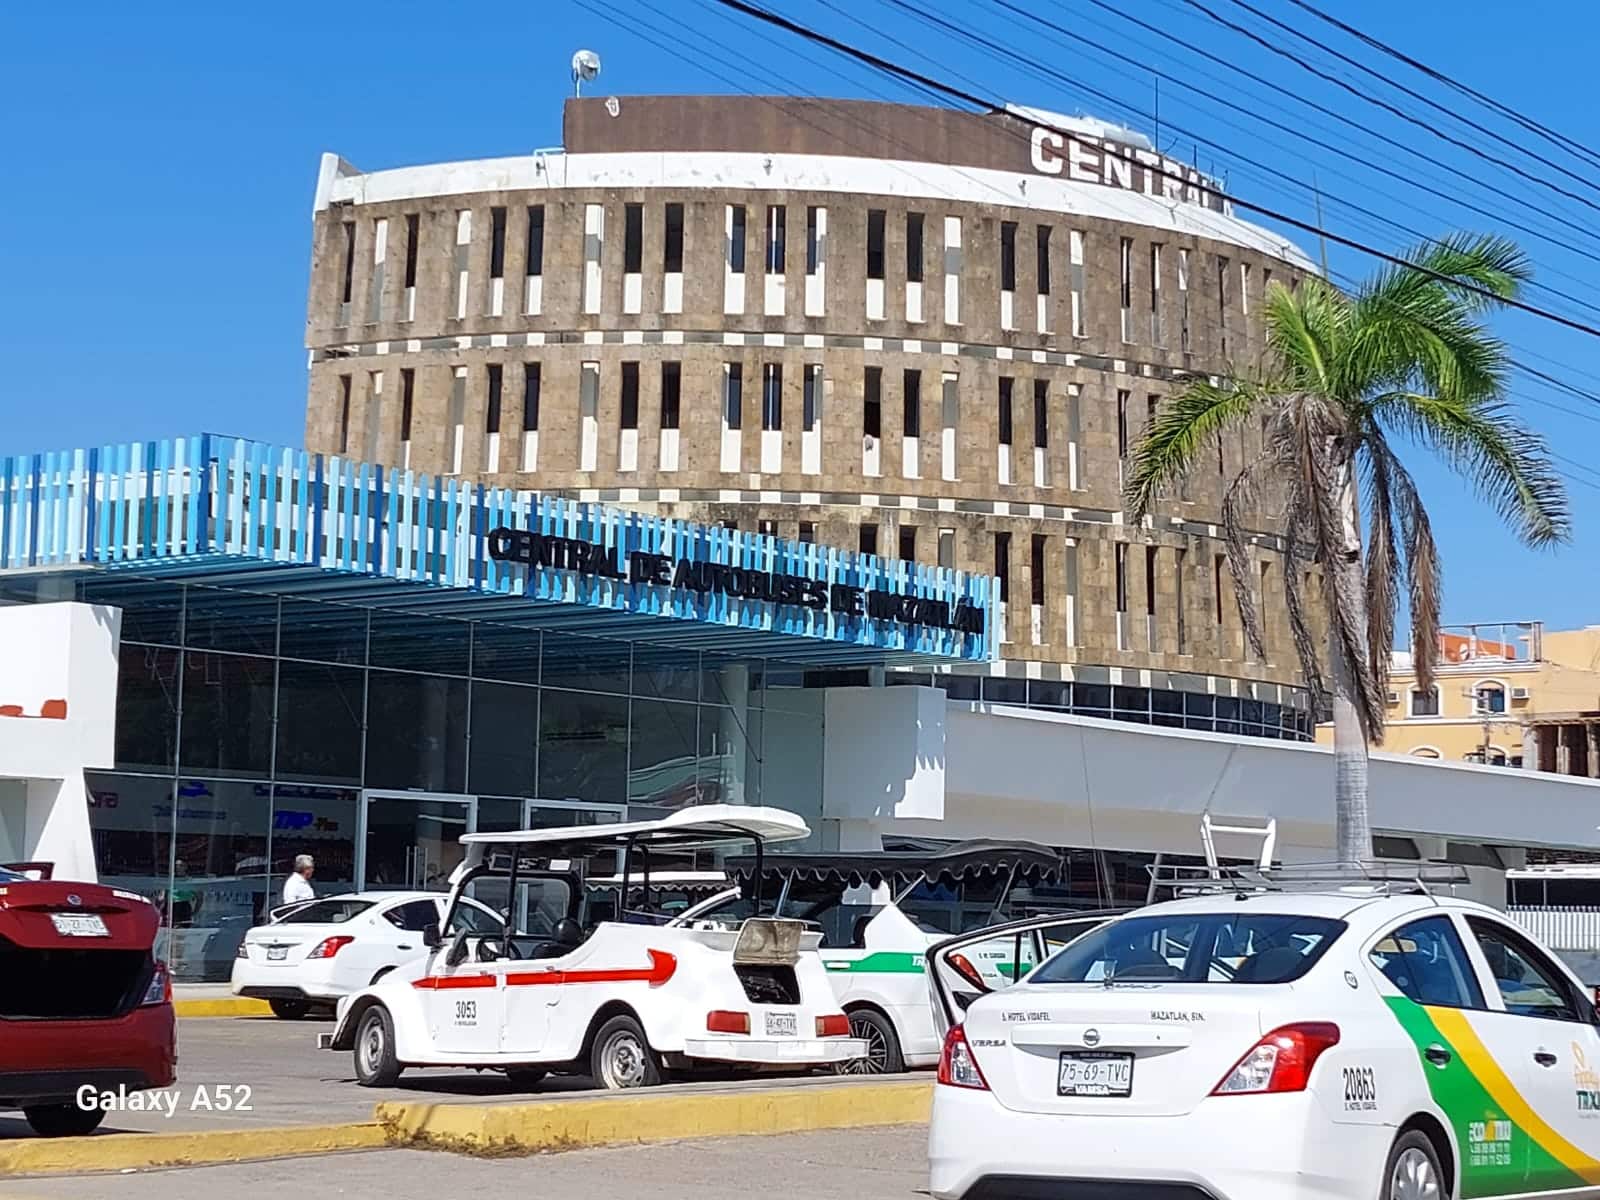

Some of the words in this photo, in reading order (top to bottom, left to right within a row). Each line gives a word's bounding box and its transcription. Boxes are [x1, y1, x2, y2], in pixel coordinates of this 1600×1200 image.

[488, 526, 627, 580] CENTRAL
[630, 551, 674, 586] DE
[674, 558, 829, 613] AUTOBUSES
[831, 582, 866, 617] DE
[455, 1000, 477, 1019] 3053
[1008, 1011, 1026, 1022] HOTEL
[971, 1039, 1007, 1047] VERSA
[1061, 1063, 1130, 1082] 75-69-TVC
[1343, 1067, 1376, 1101] 20863
